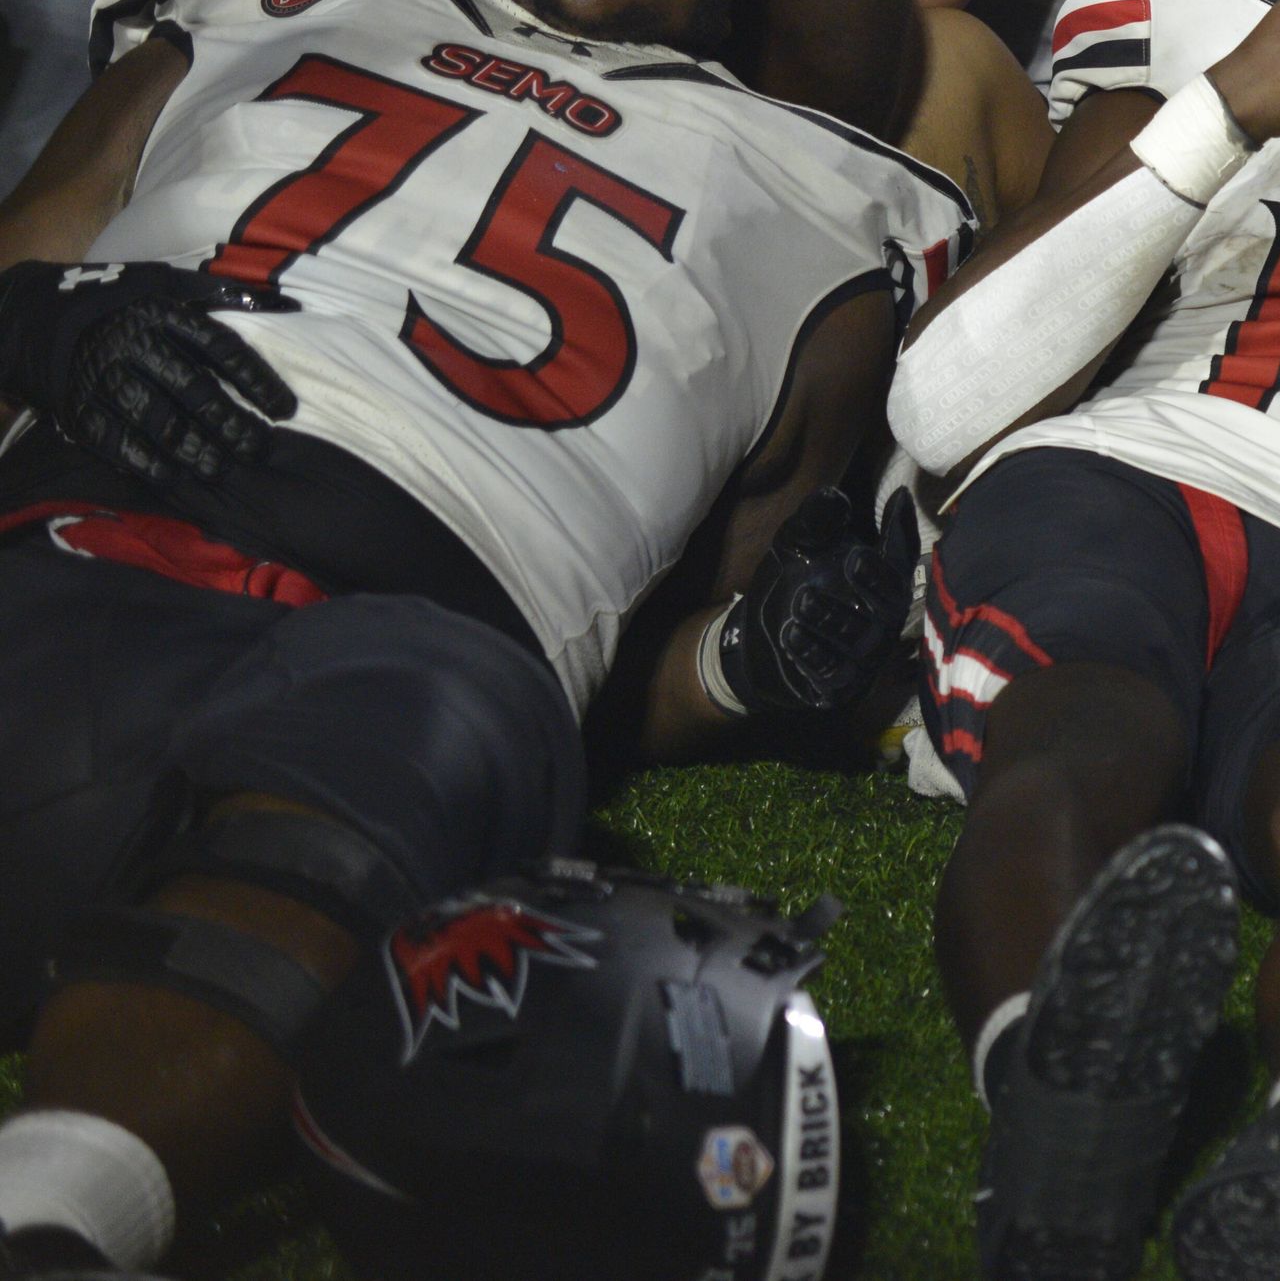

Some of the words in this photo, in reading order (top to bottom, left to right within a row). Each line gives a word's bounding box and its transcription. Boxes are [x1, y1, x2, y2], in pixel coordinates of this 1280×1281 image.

[421, 43, 623, 138] SEMO
[203, 54, 687, 432] 75
[798, 1063, 830, 1191] BRICK
